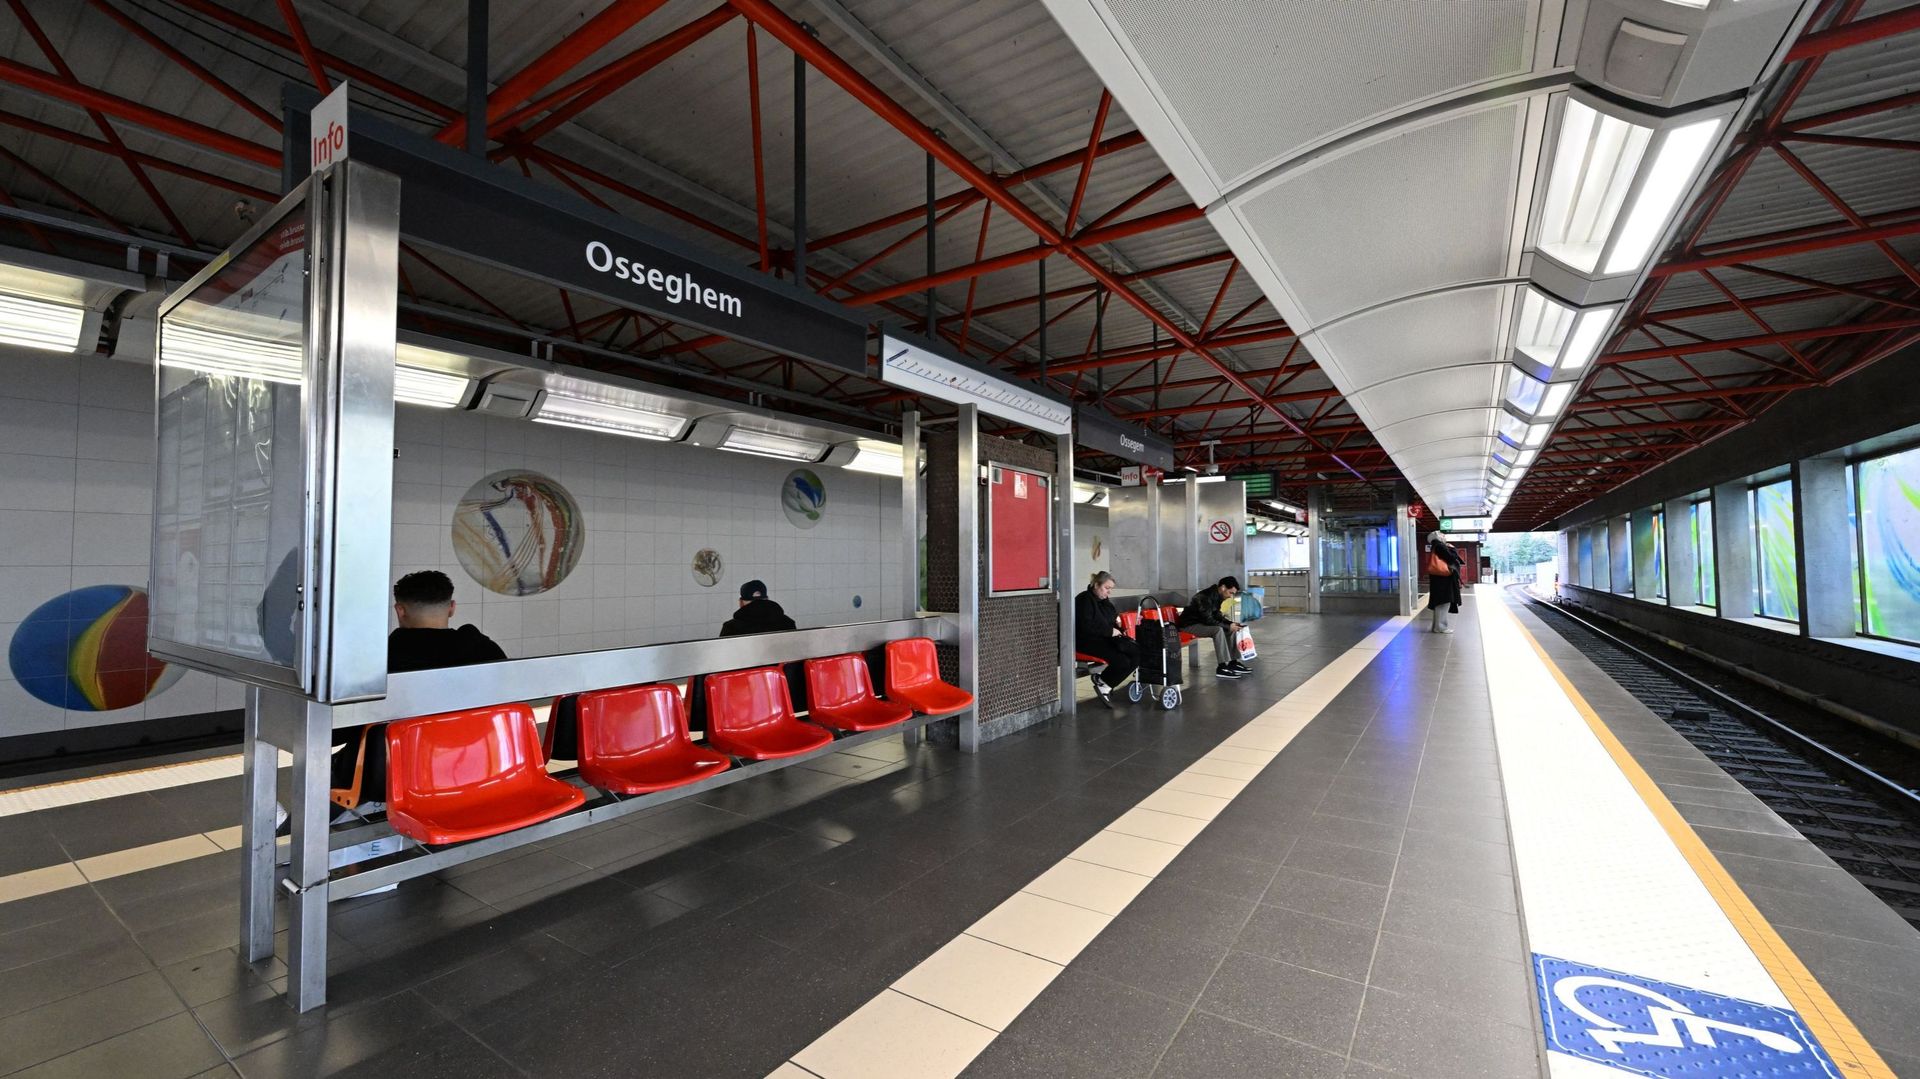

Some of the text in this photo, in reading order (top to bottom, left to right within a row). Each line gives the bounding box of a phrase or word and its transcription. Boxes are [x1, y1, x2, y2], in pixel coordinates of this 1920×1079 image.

[313, 120, 344, 167] Info
[585, 241, 742, 318] Osseghem
[1120, 433, 1145, 453] Ossegem
